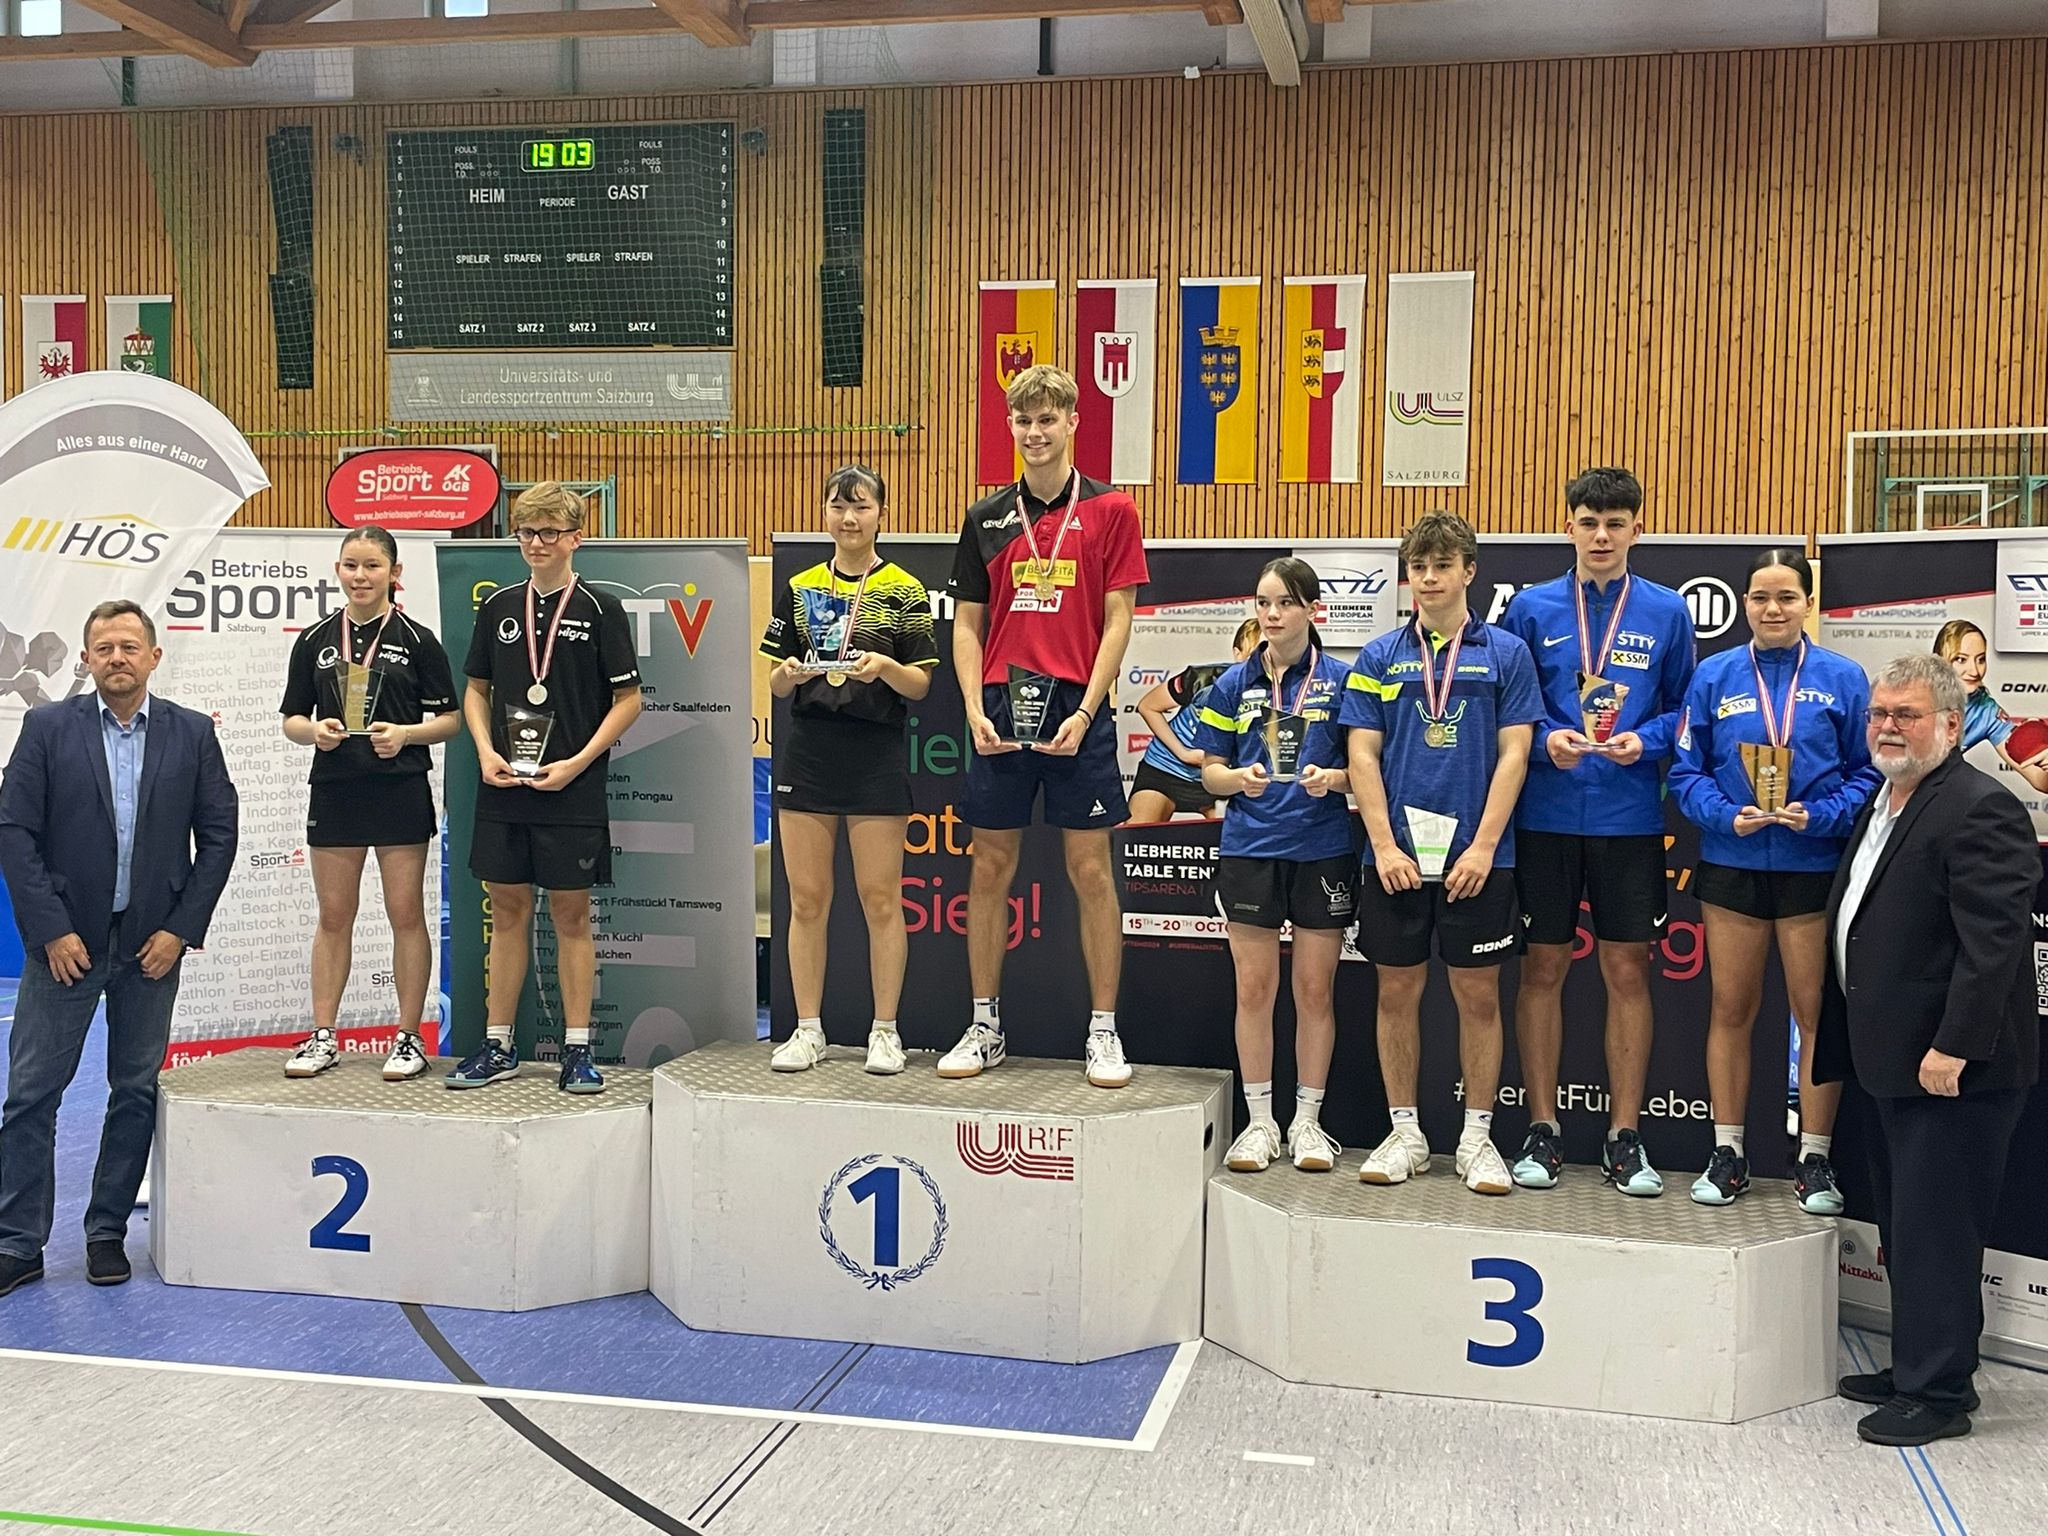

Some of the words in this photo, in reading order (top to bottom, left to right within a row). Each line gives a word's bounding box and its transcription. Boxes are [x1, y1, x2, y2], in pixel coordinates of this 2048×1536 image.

[721, 129, 727, 138] 4
[397, 138, 402, 147] 4
[454, 146, 477, 154] FOULS
[721, 147, 727, 156] 5
[397, 156, 403, 165] 5
[721, 165, 727, 173] 6
[397, 173, 403, 181] 6
[721, 182, 727, 191] 7
[397, 190, 403, 198] 7
[469, 188, 505, 204] HEIM
[607, 185, 649, 200] GAST
[539, 197, 576, 207] PERIODE
[721, 200, 727, 208] 8
[397, 207, 403, 215] 8
[721, 217, 727, 226] 9
[397, 224, 403, 232] 9
[716, 240, 726, 249] 10
[393, 246, 403, 254] 10
[456, 255, 490, 264] SPIELER
[503, 254, 542, 263] STRAFEN
[566, 253, 601, 262] SPIELER
[614, 252, 653, 261] STRAFEN
[716, 257, 725, 266] 11
[394, 263, 402, 271] 11
[393, 280, 403, 288] 12
[716, 275, 726, 283] 12
[393, 296, 403, 305] 13
[716, 292, 726, 301] 13
[393, 313, 403, 322] 14
[716, 309, 726, 318] 14
[459, 324, 480, 333] SATZ
[481, 323, 486, 332] 1
[517, 324, 538, 333] SATZ
[539, 323, 545, 332] 2
[569, 323, 590, 332] SATZ
[591, 323, 597, 332] 3
[627, 323, 649, 332] SATZ
[650, 322, 656, 331] 4
[716, 327, 726, 336] 15
[393, 330, 403, 339] 15
[499, 368, 584, 384] Universitäts-
[588, 368, 613, 383] und
[460, 389, 593, 406] Landessportzentrum
[596, 388, 655, 407] Salzburg
[57, 435, 93, 452] Alles
[97, 434, 125, 447] aus
[129, 436, 167, 454] einer
[169, 445, 209, 471] Hand
[378, 464, 423, 474] Betriebs
[443, 464, 472, 481] AK
[1387, 470, 1460, 480] SALZBURG
[357, 469, 433, 501] Sport
[58, 522, 169, 565] HÖS
[211, 559, 308, 579] Betriebs
[166, 569, 340, 633] Sport
[1160, 606, 1247, 617] CHAMPIONSHIPS
[1859, 608, 1947, 618] CHAMPIONSHIPS
[227, 623, 267, 634] Salzburg
[621, 599, 715, 660] TV
[1134, 625, 1167, 634] UPPER
[1169, 625, 1212, 635] AUSTRIA
[1215, 626, 1235, 635] 202
[1832, 629, 1864, 638] UPPER
[1867, 629, 1912, 638] AUSTRIA
[1915, 630, 1934, 639] 202
[1617, 632, 1656, 650] STTV
[1626, 653, 1648, 664] SSM
[171, 664, 233, 680] Eisstock
[182, 680, 224, 695] Stock
[201, 694, 264, 710] Triathlon
[672, 702, 731, 713] Saalfelden
[616, 791, 630, 800] im
[632, 791, 673, 803] Pongau
[1124, 843, 1206, 860] LIEBHERR
[1209, 846, 1220, 860] E
[250, 854, 290, 869] Sport
[1123, 863, 1174, 879] TABLE
[1178, 865, 1215, 880] TEN
[1124, 881, 1197, 895] TIPSARENA
[610, 896, 667, 909] Frühstückl
[669, 898, 722, 912] Tamsweg
[590, 914, 611, 924] dorf
[209, 917, 286, 936] phaltstock
[612, 932, 643, 942] Kuchl
[1472, 934, 1514, 954] DONIC
[212, 950, 303, 966] Kegel-Einzel
[595, 950, 632, 960] alchen
[178, 1001, 219, 1016] Stock
[233, 997, 306, 1012] Eishockey
[194, 1016, 256, 1032] Triathlon
[309, 1155, 372, 1253] 2
[847, 1166, 900, 1268] 1
[1466, 1257, 1545, 1368] 3
